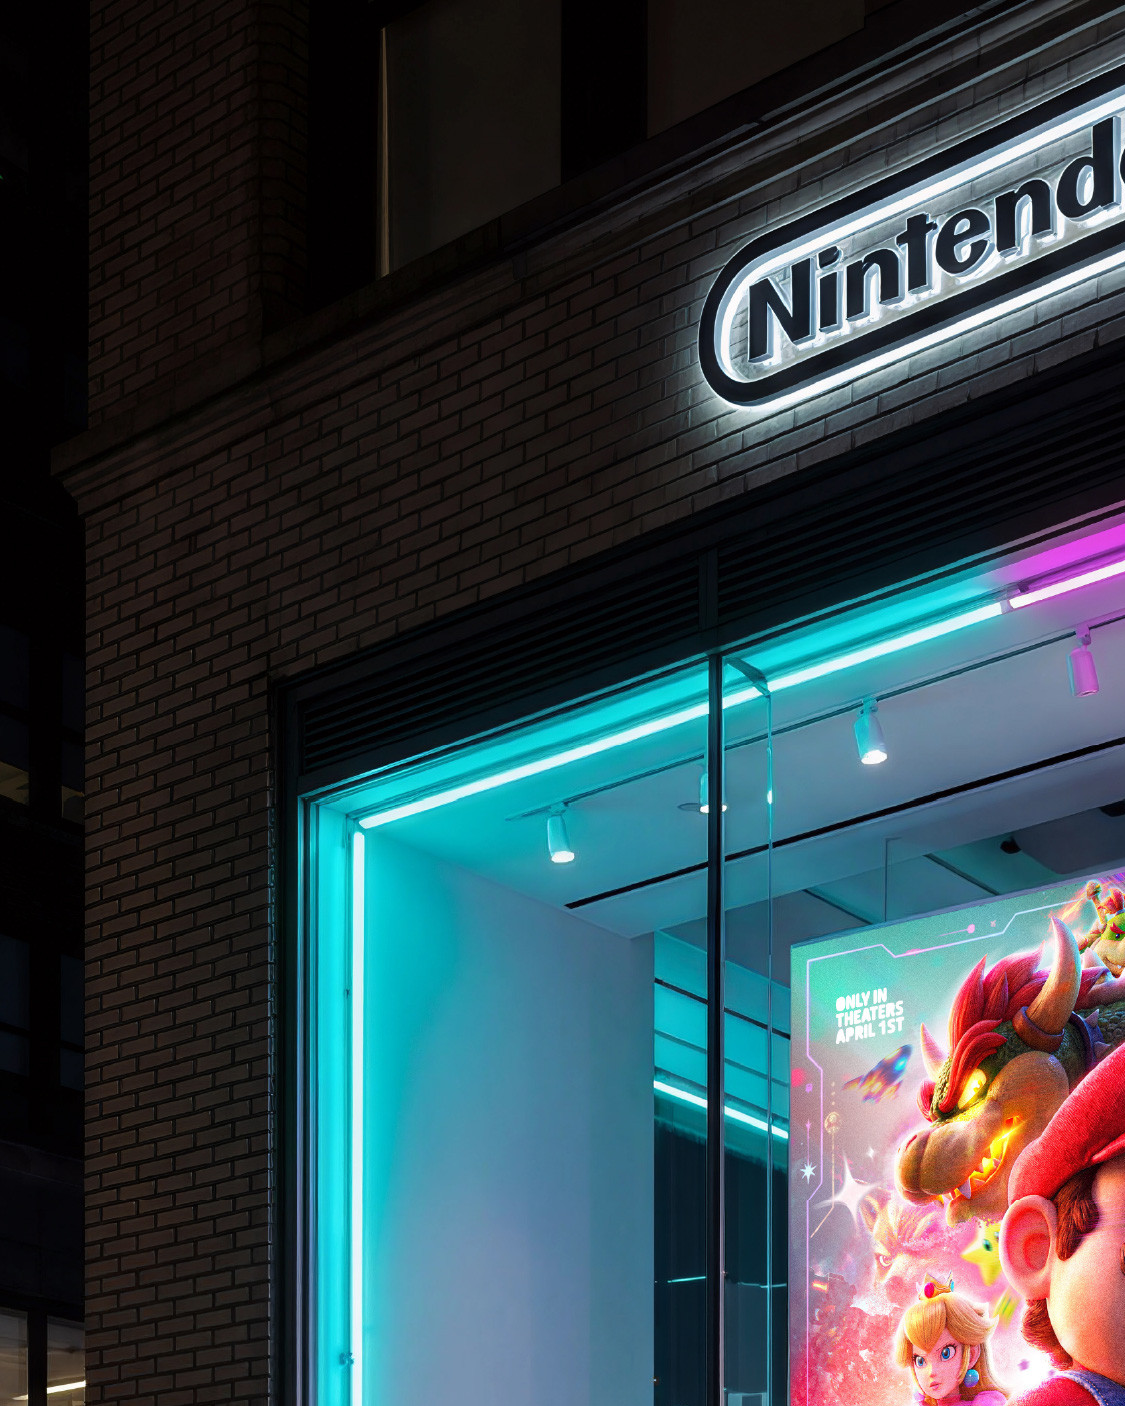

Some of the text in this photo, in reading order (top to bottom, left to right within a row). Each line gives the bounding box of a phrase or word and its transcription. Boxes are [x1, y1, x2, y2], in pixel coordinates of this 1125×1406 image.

[835, 987, 888, 1012] ONLY IN
[835, 1000, 904, 1028] THEATERS
[835, 1016, 905, 1045] APRIL 1ST
